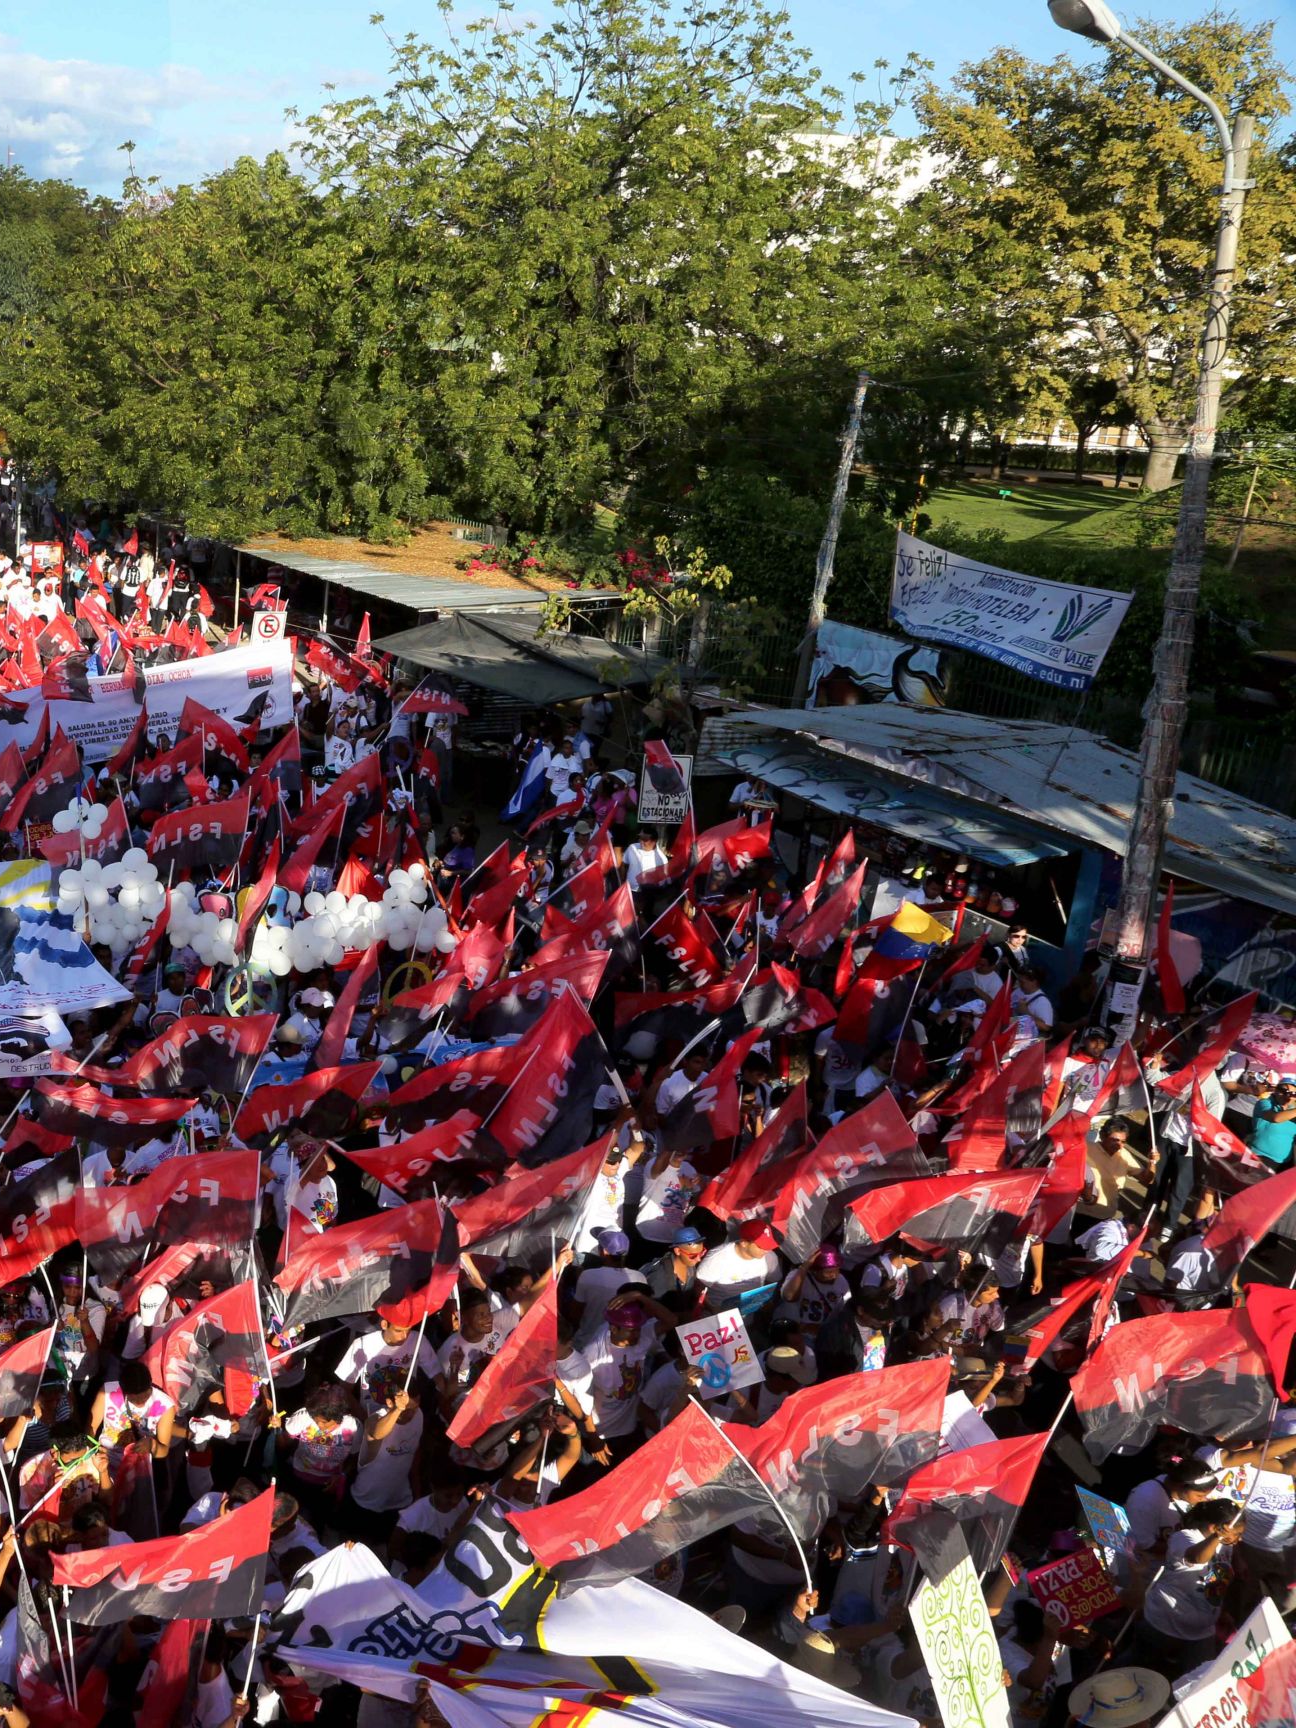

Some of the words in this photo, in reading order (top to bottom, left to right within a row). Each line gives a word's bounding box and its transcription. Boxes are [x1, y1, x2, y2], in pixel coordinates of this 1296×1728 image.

[248, 673, 272, 684] FSLN
[67, 722, 96, 733] SALUDA
[112, 730, 131, 741] AUGU
[658, 795, 670, 806] NO
[641, 807, 684, 817] ESTACIONAR
[654, 932, 713, 989] FSLN
[684, 1317, 742, 1356] Paz!
